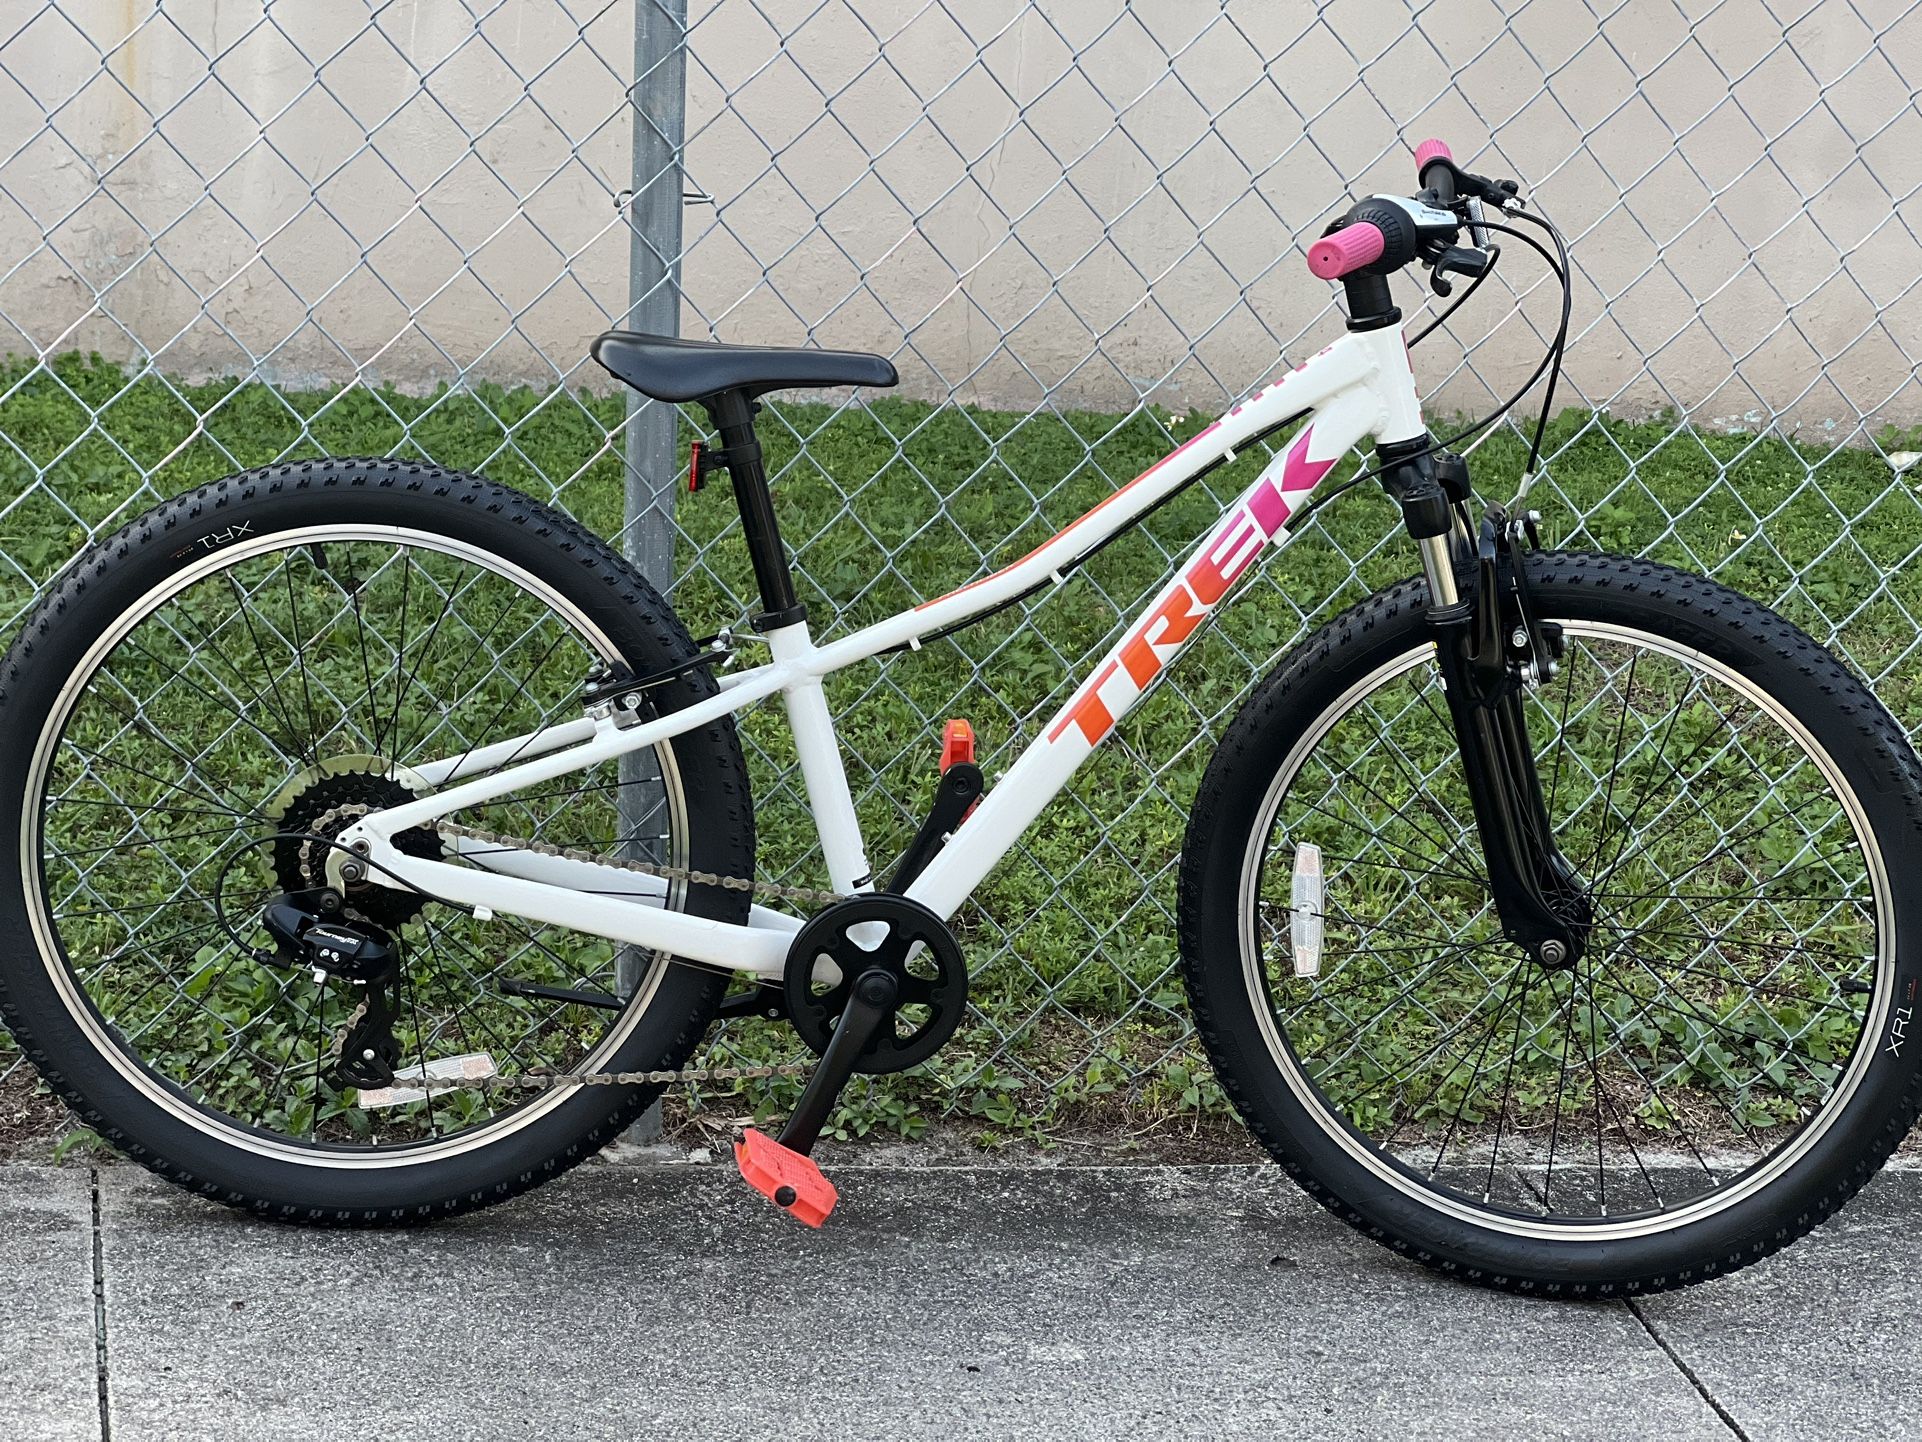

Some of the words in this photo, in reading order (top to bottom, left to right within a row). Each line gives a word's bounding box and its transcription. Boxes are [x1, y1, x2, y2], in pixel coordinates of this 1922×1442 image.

[196, 519, 255, 549] XR1
[1047, 422, 1338, 748] TREK
[1884, 1006, 1913, 1058] XR1
